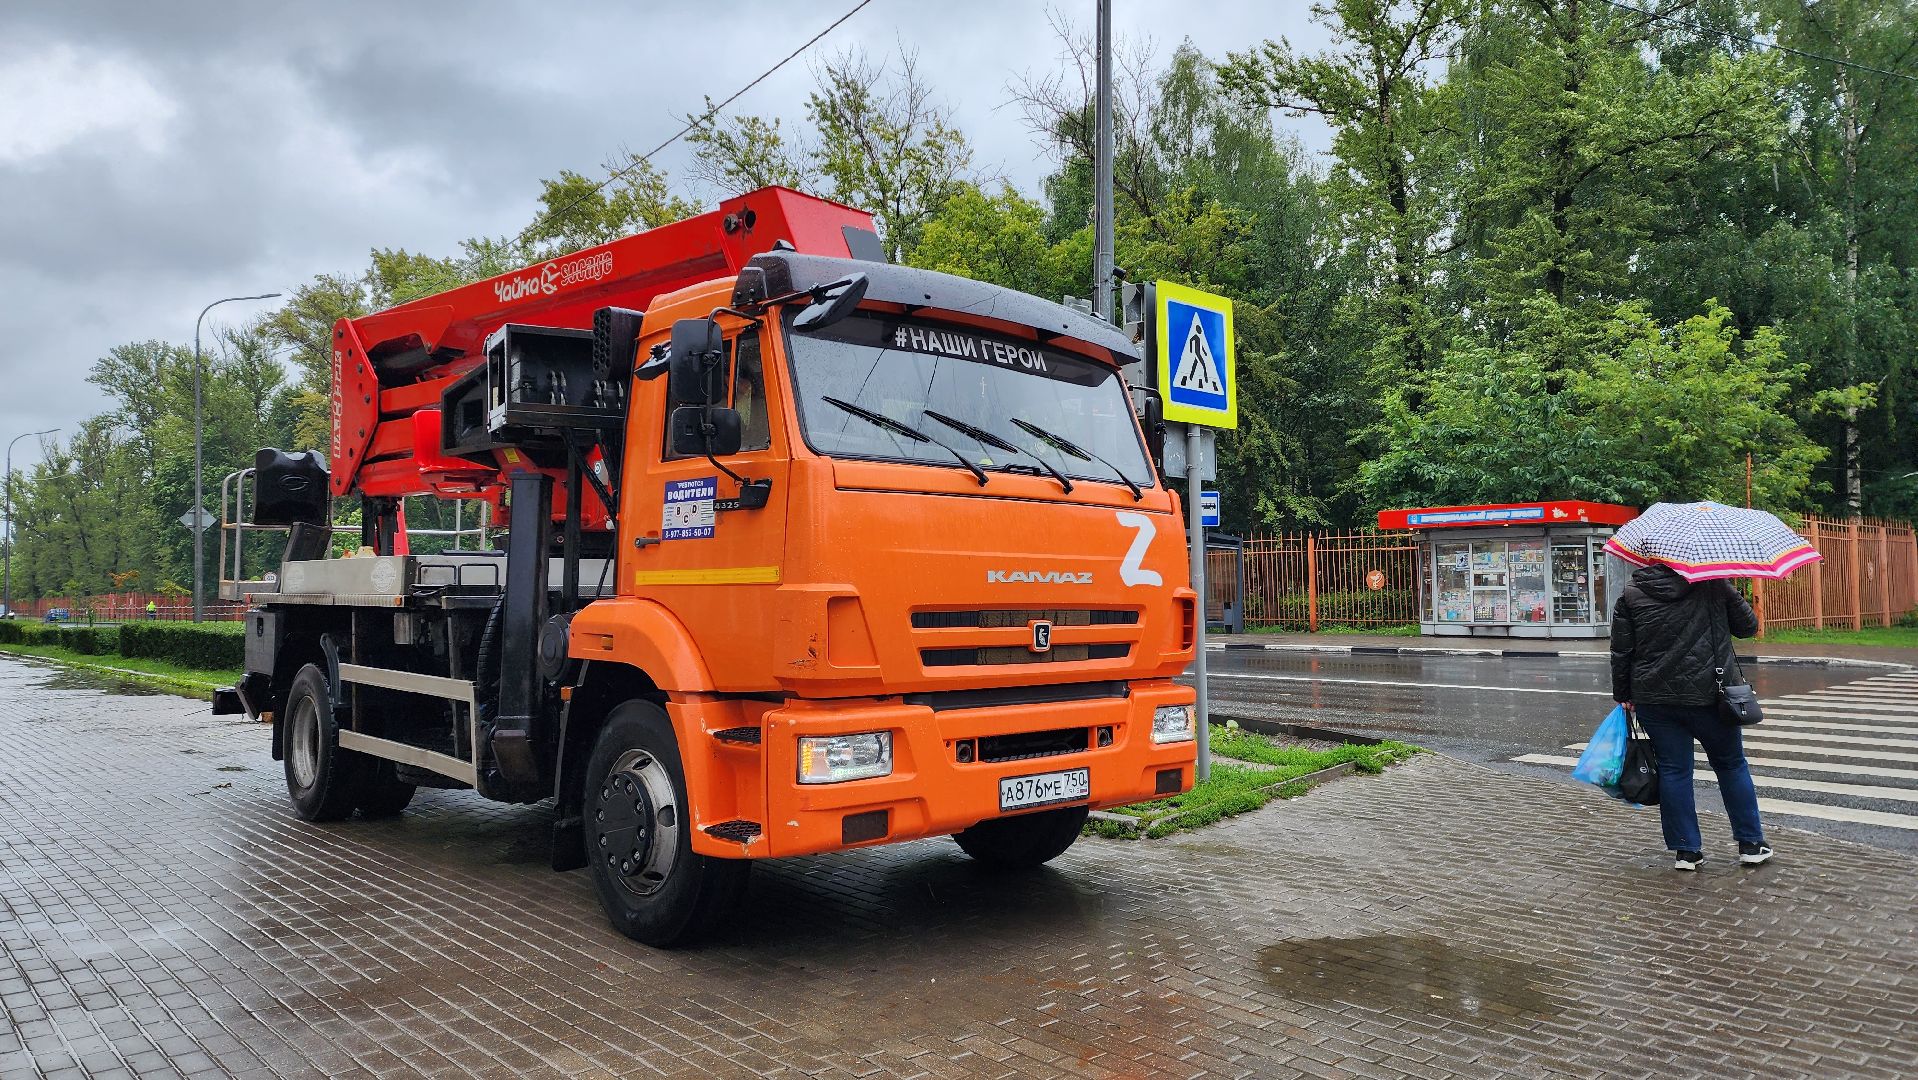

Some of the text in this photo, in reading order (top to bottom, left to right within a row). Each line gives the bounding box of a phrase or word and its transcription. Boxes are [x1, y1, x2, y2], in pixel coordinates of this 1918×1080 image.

[494, 251, 613, 302] Чайка socage
[895, 326, 1048, 372] #НАШИ ГЕРОИ
[667, 486, 714, 501] ВОДИТЕЛИ
[714, 501, 740, 510] 4325
[1115, 511, 1163, 587] Z
[987, 570, 1093, 584] KAMAZ
[1063, 771, 1085, 787] 750
